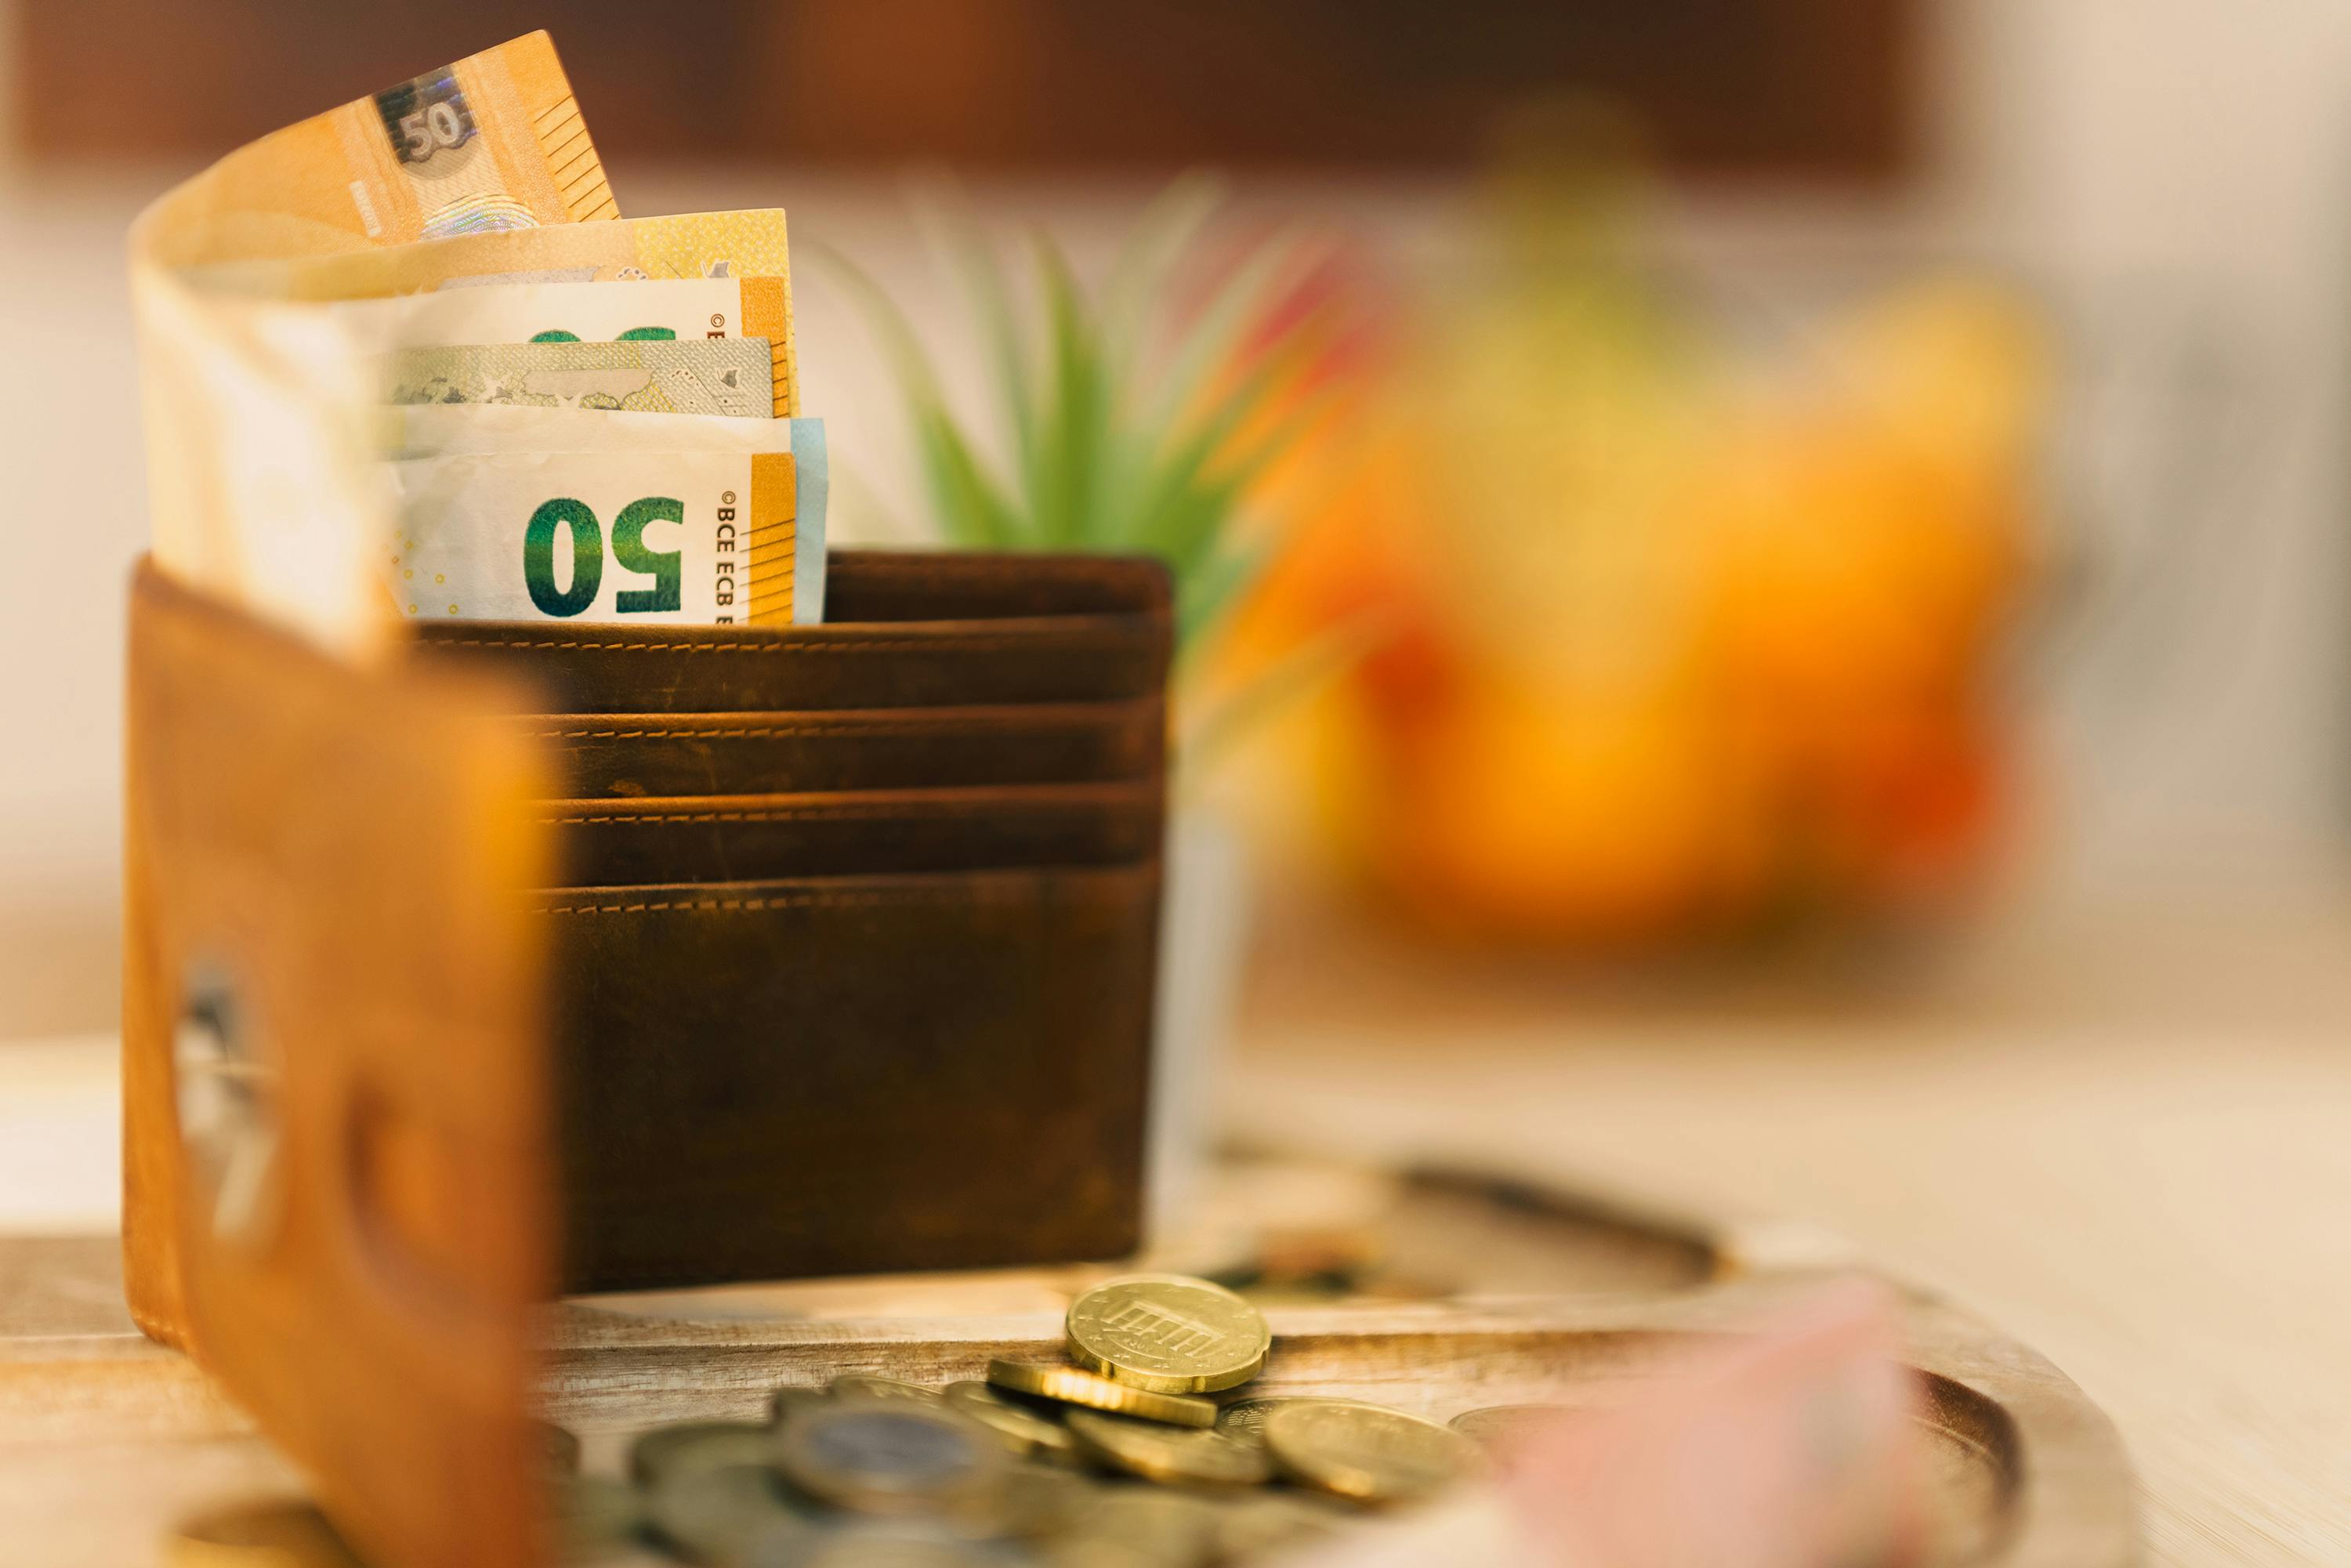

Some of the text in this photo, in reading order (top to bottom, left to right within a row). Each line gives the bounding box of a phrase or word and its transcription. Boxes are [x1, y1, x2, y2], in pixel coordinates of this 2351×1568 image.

[400, 103, 459, 156] 50
[523, 497, 684, 617] 50
[716, 562, 734, 606] ECB
